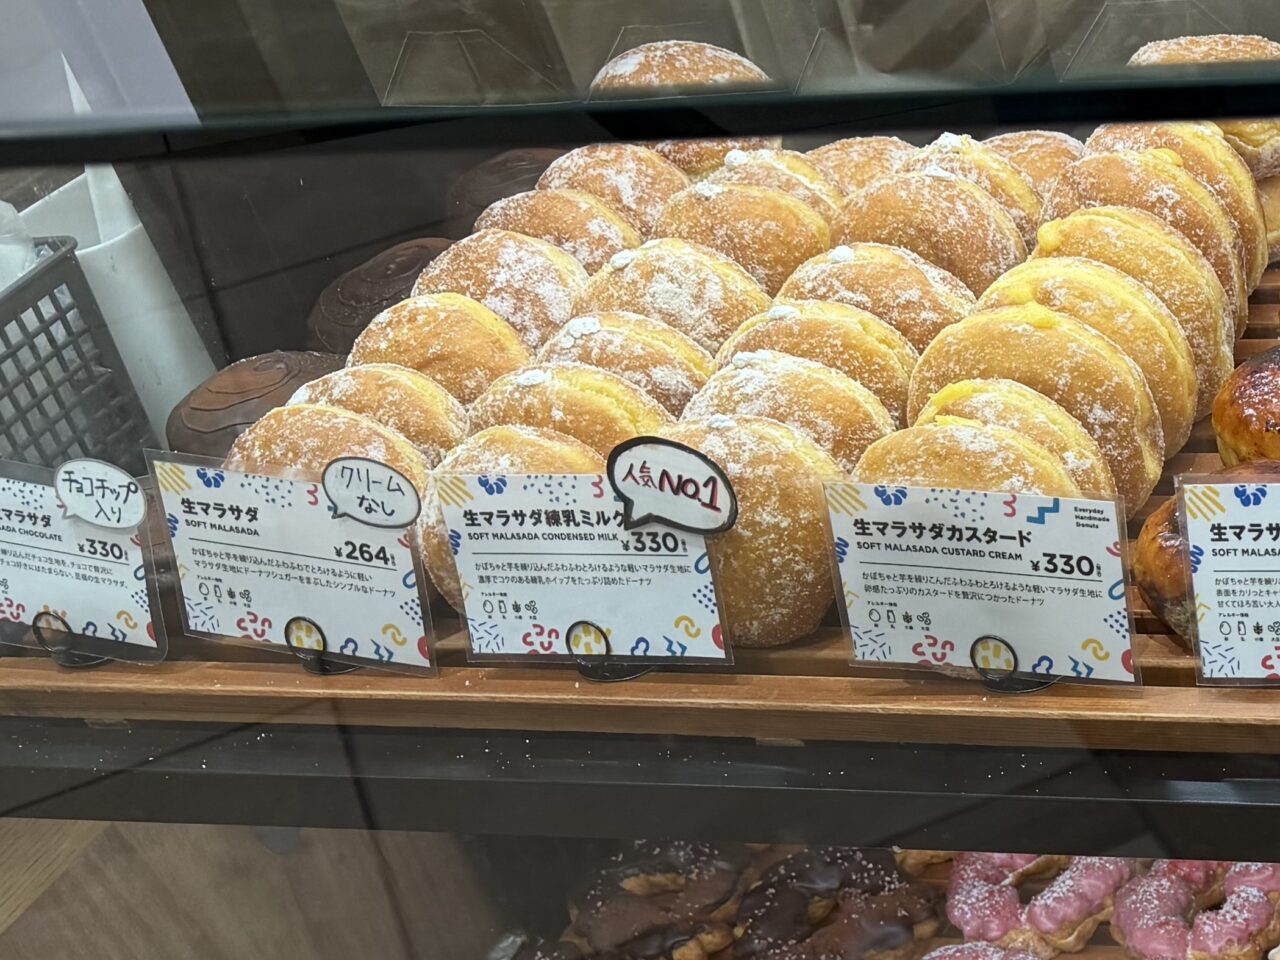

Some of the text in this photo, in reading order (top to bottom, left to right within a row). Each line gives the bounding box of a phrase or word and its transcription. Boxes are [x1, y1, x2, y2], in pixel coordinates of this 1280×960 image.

[62, 471, 138, 504] チョコチップ
[339, 464, 406, 498] クリーム
[95, 500, 121, 523] 入り
[181, 497, 259, 523] 生マラサダ
[356, 495, 395, 517] なし
[0, 508, 51, 528] マラサダ
[185, 519, 260, 537] SOFT MALASADA
[462, 509, 625, 528] 生マラサダ練乳ミルク
[0, 525, 62, 542] ADA CHOCOLATE
[467, 532, 619, 542] SOFT MALASADA CONDENSED MILK
[621, 532, 679, 553] ¥330
[853, 517, 1032, 548] 生マラサダカスタード
[78, 538, 123, 561] ¥330
[333, 540, 390, 567] ¥264
[857, 541, 1023, 562] SOFT MALASADA CUSTARD CREAM
[1212, 548, 1238, 557] SOFT
[1030, 552, 1095, 577] ¥330
